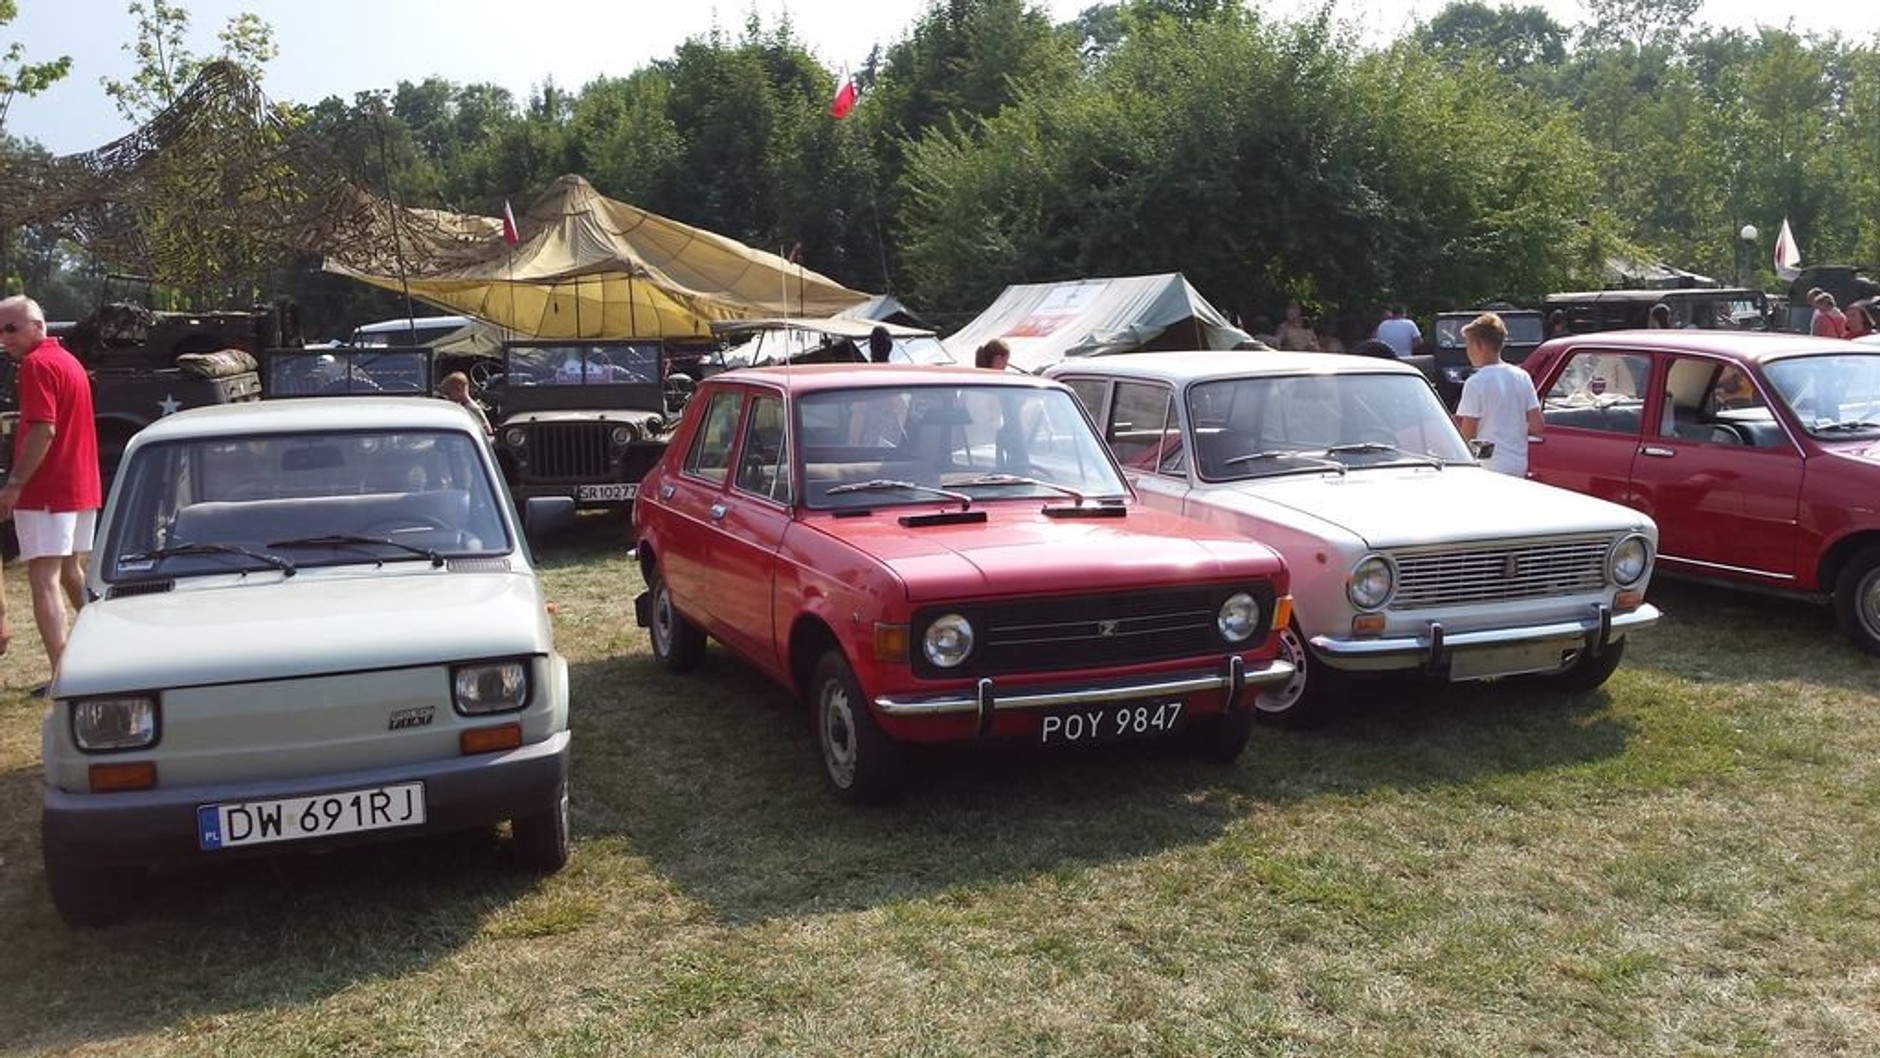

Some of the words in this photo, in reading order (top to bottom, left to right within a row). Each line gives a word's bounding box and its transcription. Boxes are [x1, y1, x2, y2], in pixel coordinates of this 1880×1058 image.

[1042, 710, 1104, 743] POY
[1116, 703, 1182, 735] 9847
[227, 804, 282, 842] DW
[300, 789, 413, 832] 691RJ
[205, 832, 220, 842] PL
